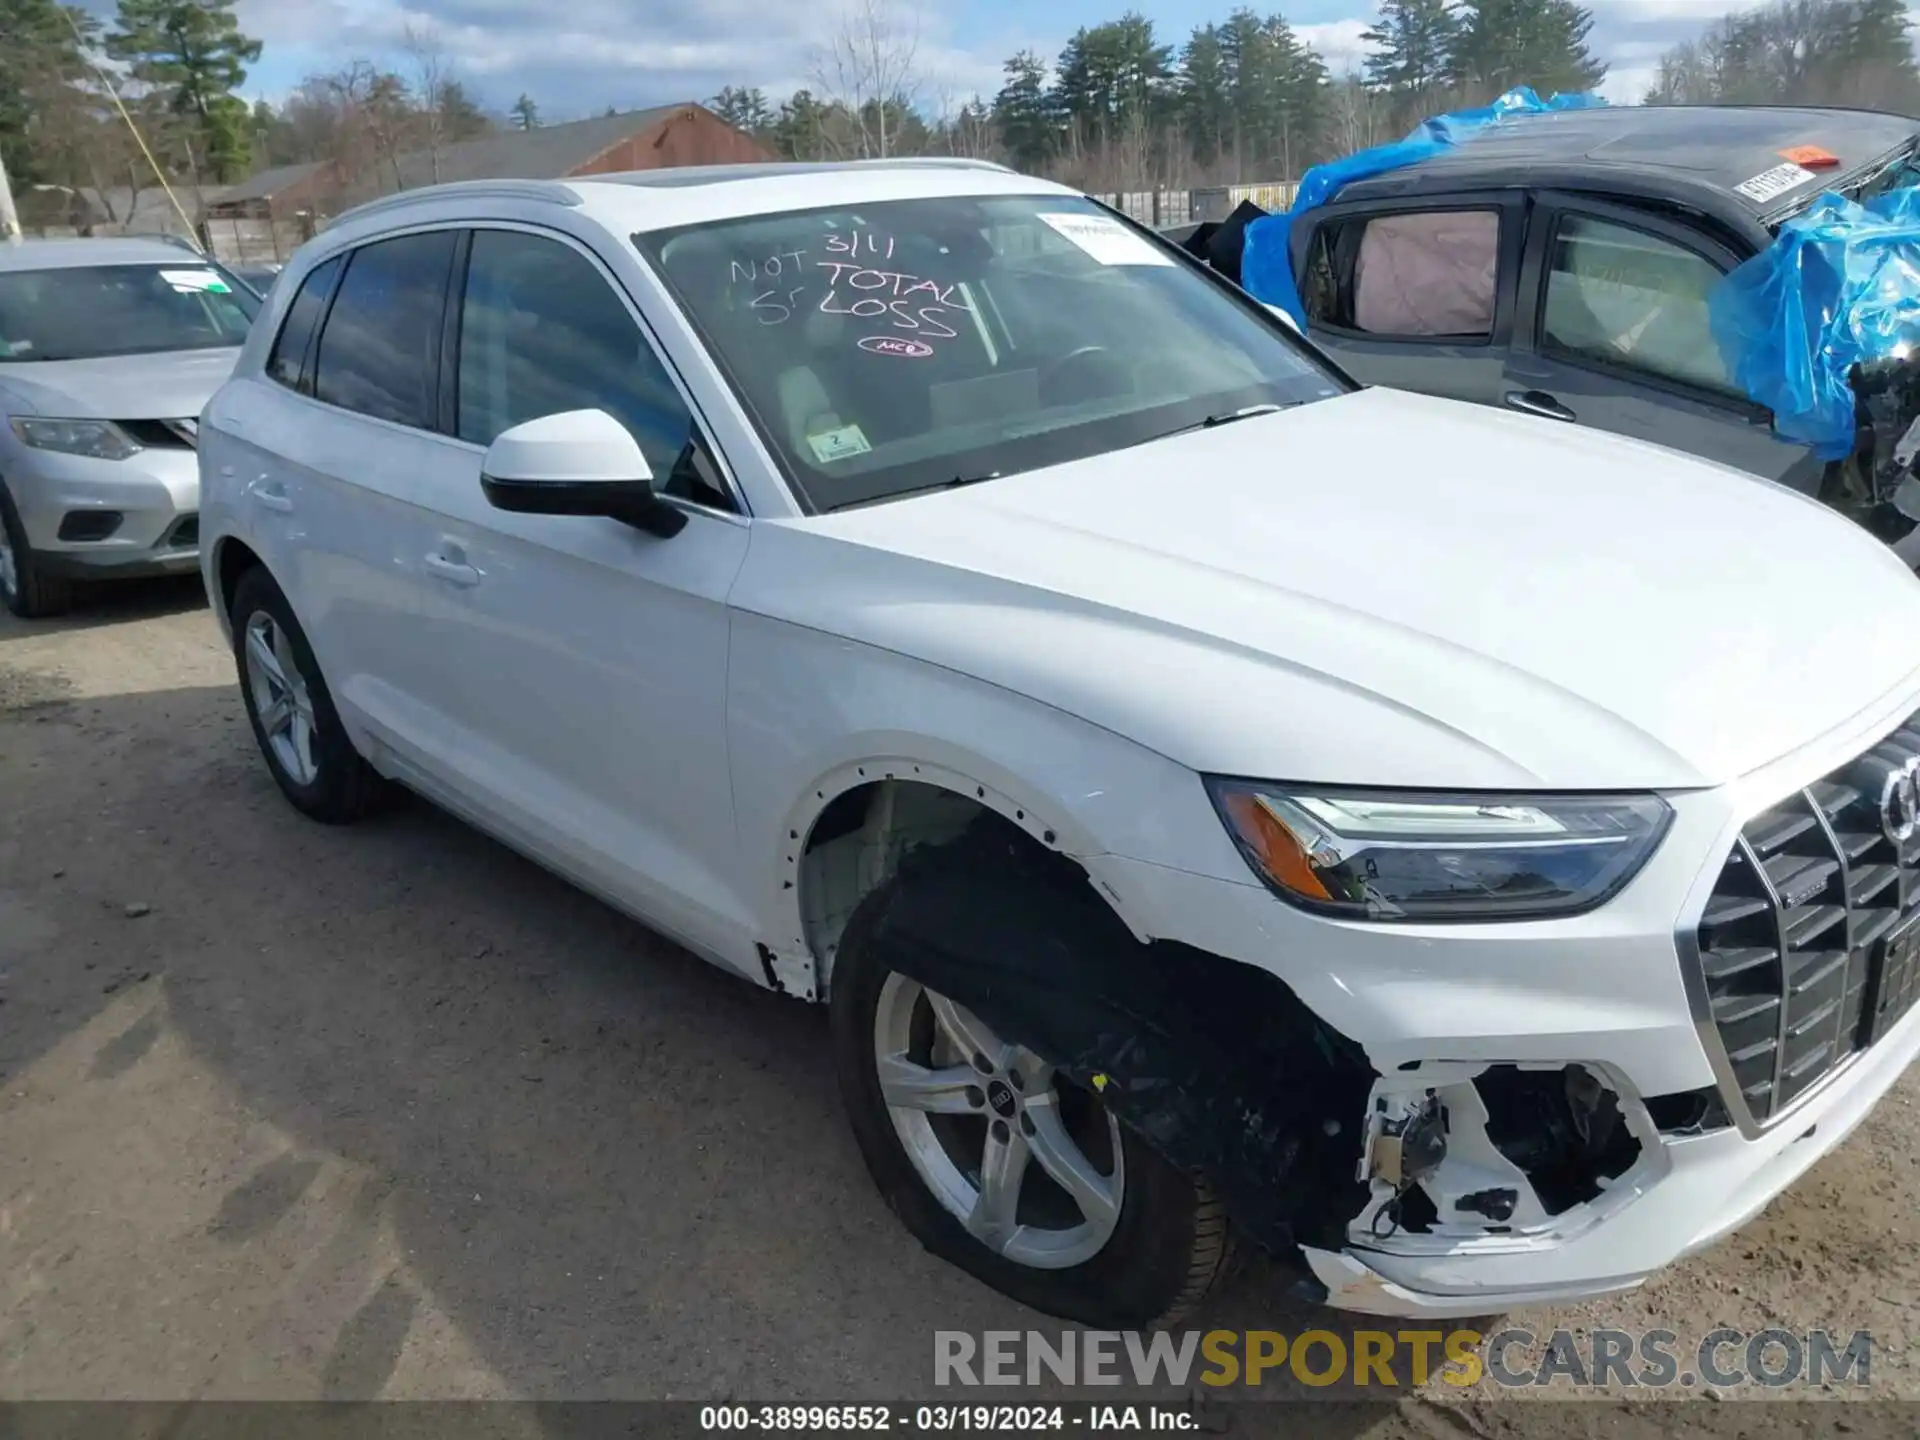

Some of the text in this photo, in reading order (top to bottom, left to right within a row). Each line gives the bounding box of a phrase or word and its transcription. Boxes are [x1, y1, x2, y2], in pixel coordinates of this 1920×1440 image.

[822, 231, 894, 258] 3/11
[731, 250, 807, 283] NOT
[816, 261, 972, 311] TOTAL
[820, 289, 958, 338] LOSS
